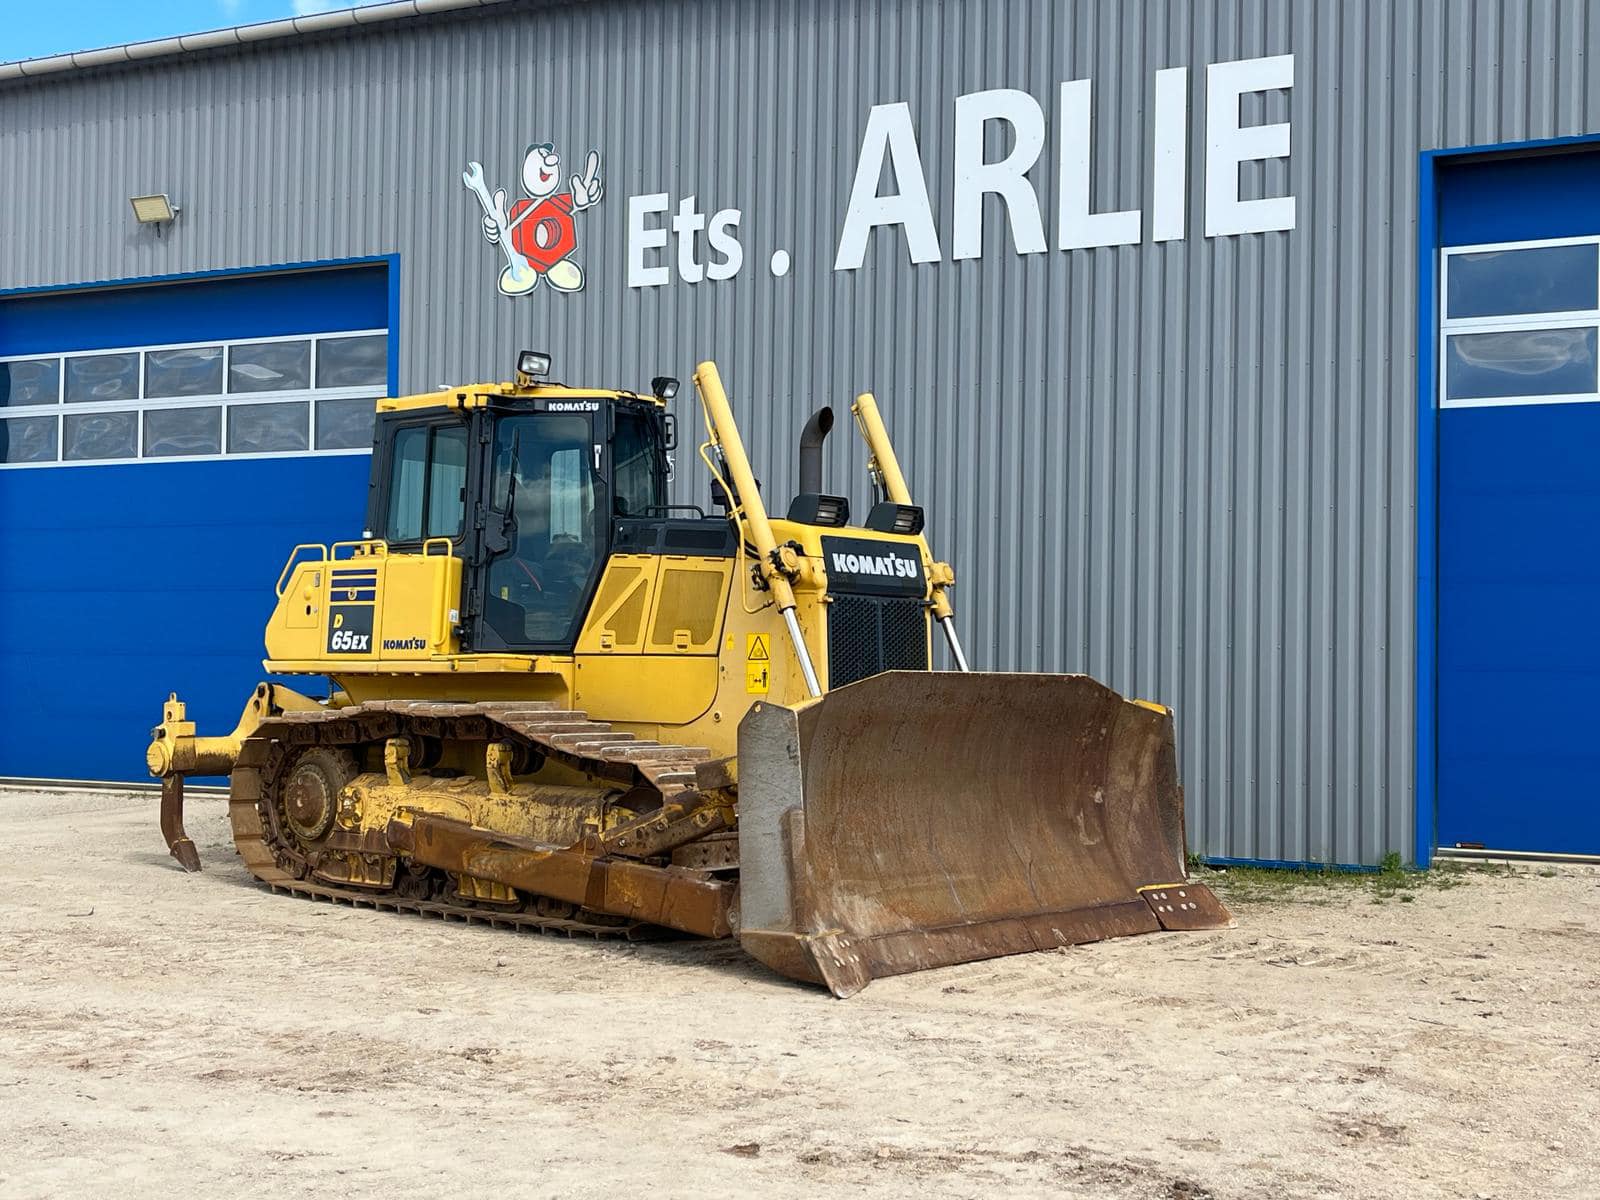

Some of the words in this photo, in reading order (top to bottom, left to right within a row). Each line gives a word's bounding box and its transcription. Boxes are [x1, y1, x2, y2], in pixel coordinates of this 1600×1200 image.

[834, 54, 1296, 271] ARLIE
[548, 400, 600, 412] KOMATSU
[832, 552, 918, 578] KOMATSU
[333, 613, 344, 629] D
[331, 630, 369, 650] 65EX
[383, 637, 426, 650] KOMATSU
